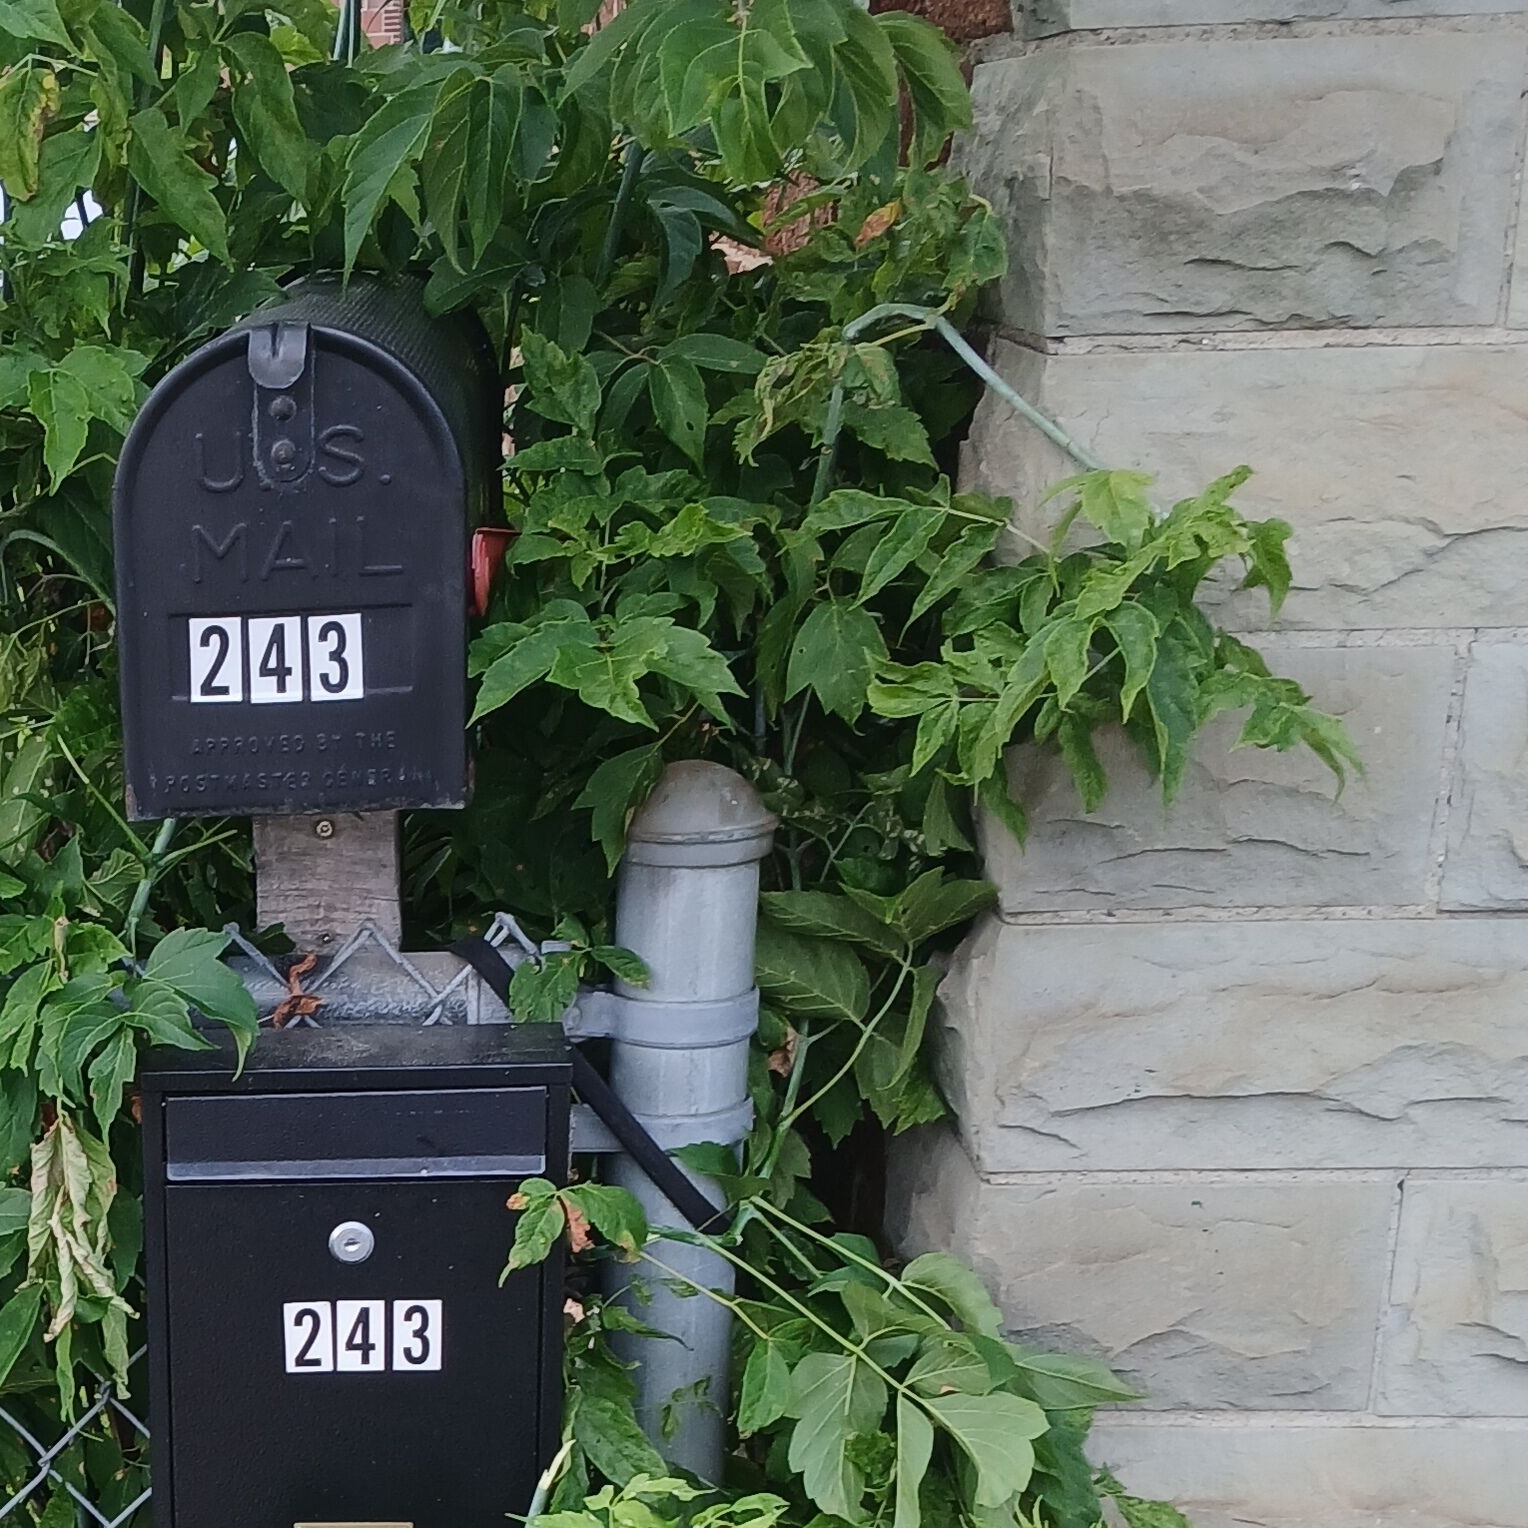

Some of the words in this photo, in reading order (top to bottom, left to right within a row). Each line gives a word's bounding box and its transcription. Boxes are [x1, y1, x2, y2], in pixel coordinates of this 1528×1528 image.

[191, 516, 403, 582] MAIL
[199, 621, 350, 696] 243
[353, 728, 398, 752] THE
[293, 1305, 430, 1367] 243
